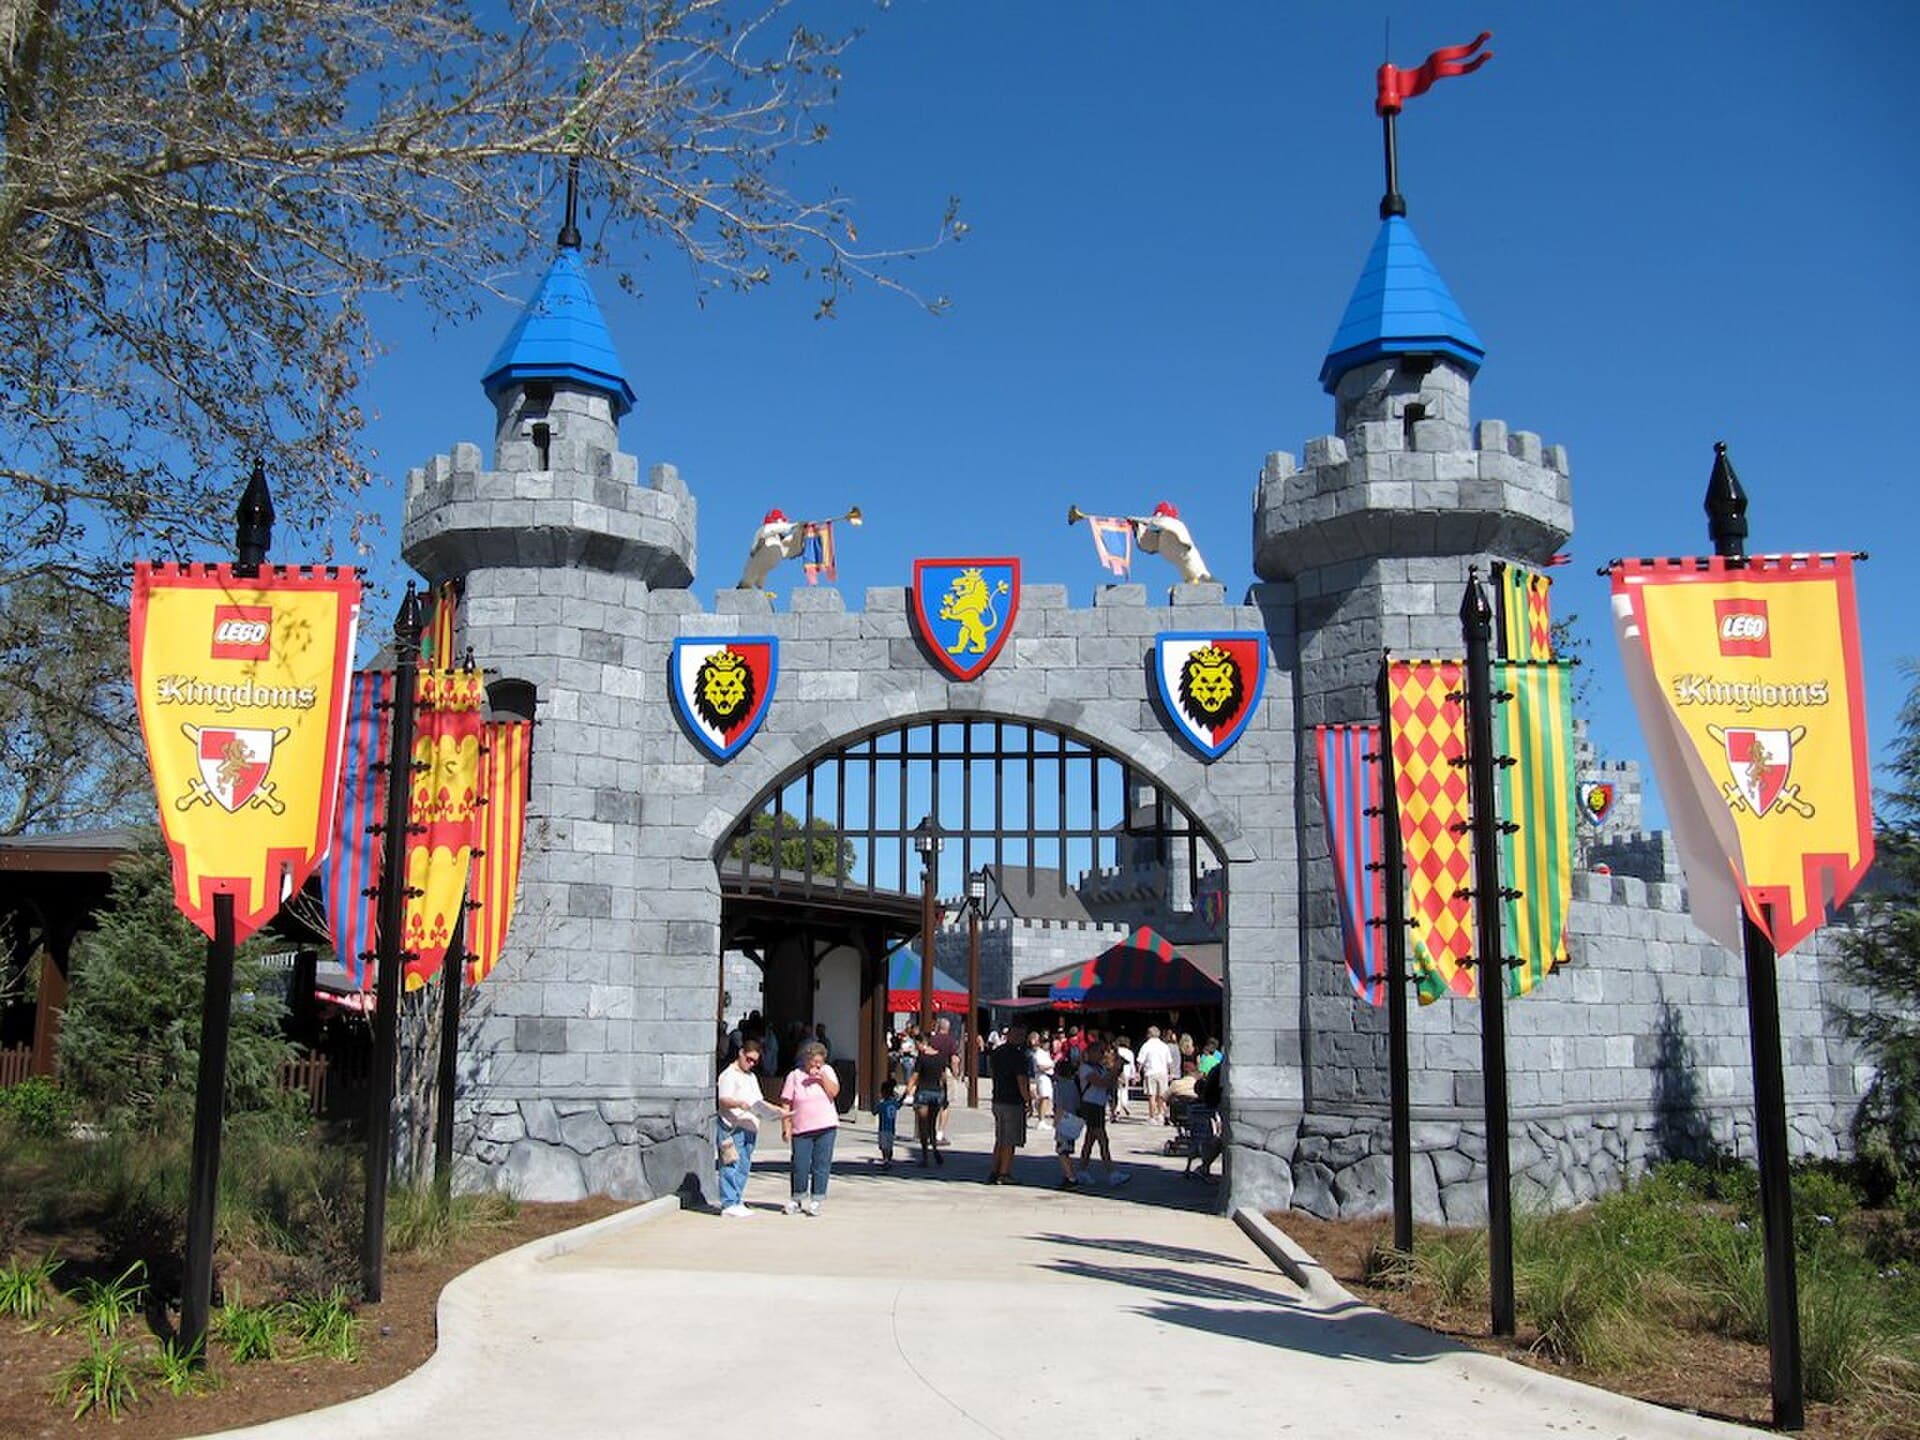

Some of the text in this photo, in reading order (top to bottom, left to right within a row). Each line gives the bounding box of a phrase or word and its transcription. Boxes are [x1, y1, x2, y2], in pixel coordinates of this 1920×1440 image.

[216, 620, 268, 643] LEGO
[1721, 615, 1766, 639] LEGO
[156, 674, 317, 713] Kingdoms
